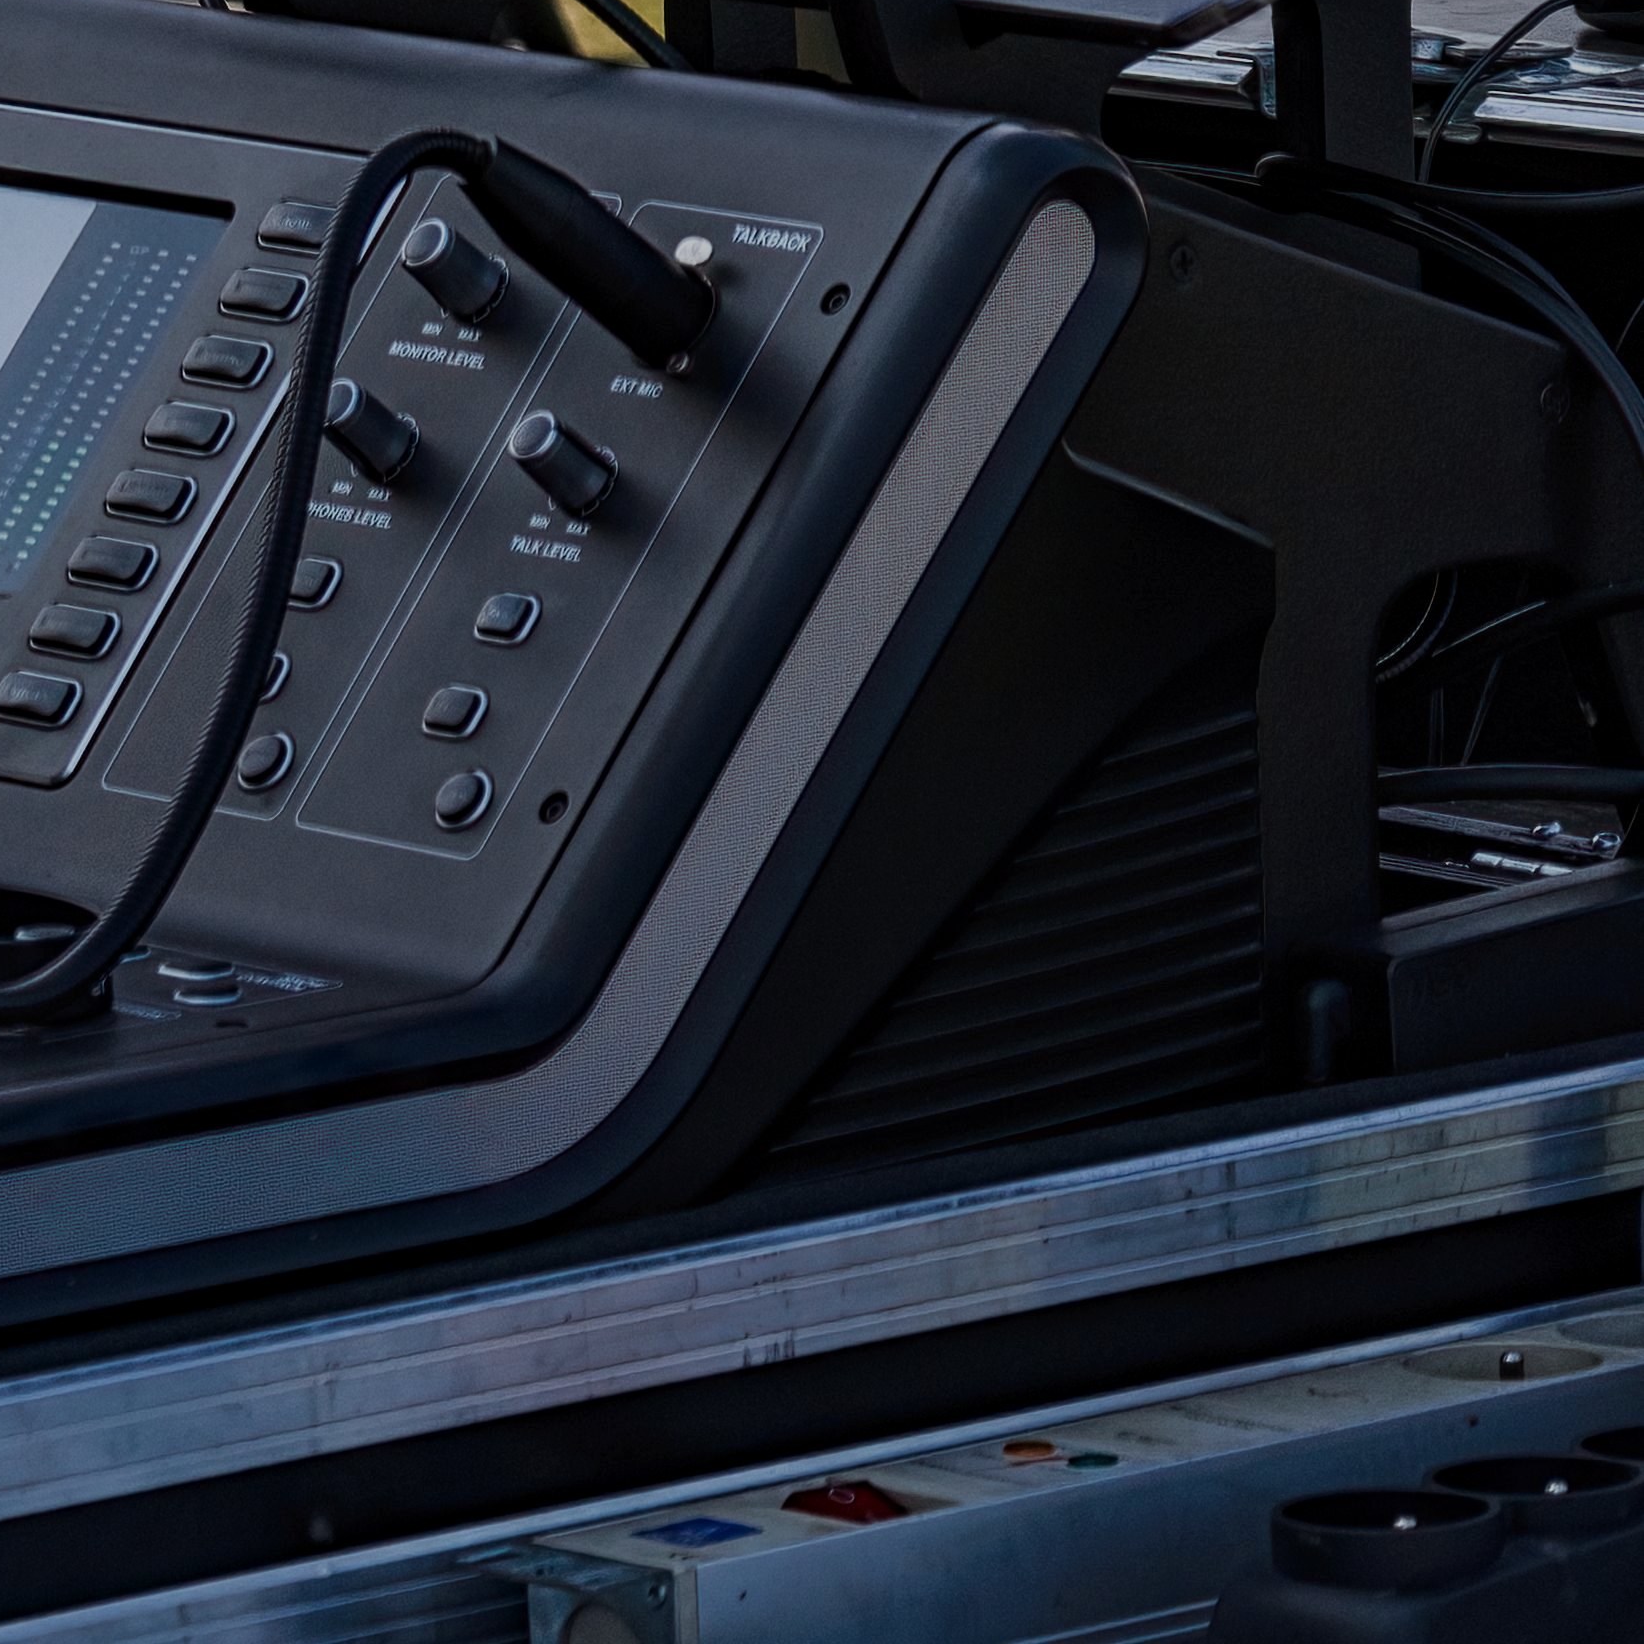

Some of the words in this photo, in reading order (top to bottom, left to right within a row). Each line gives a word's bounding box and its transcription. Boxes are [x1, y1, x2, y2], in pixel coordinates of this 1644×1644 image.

[732, 224, 813, 252] TALKBACK
[457, 328, 480, 342] MAX
[388, 340, 449, 363] MONITOR
[446, 350, 485, 370] LEVEL
[610, 375, 638, 394] EXT
[636, 380, 663, 398] MIC
[368, 488, 390, 501] MAX
[353, 509, 392, 529] LEVEL
[566, 522, 589, 536] MAX
[510, 535, 541, 555] TALK
[539, 542, 581, 562] LEVEL
